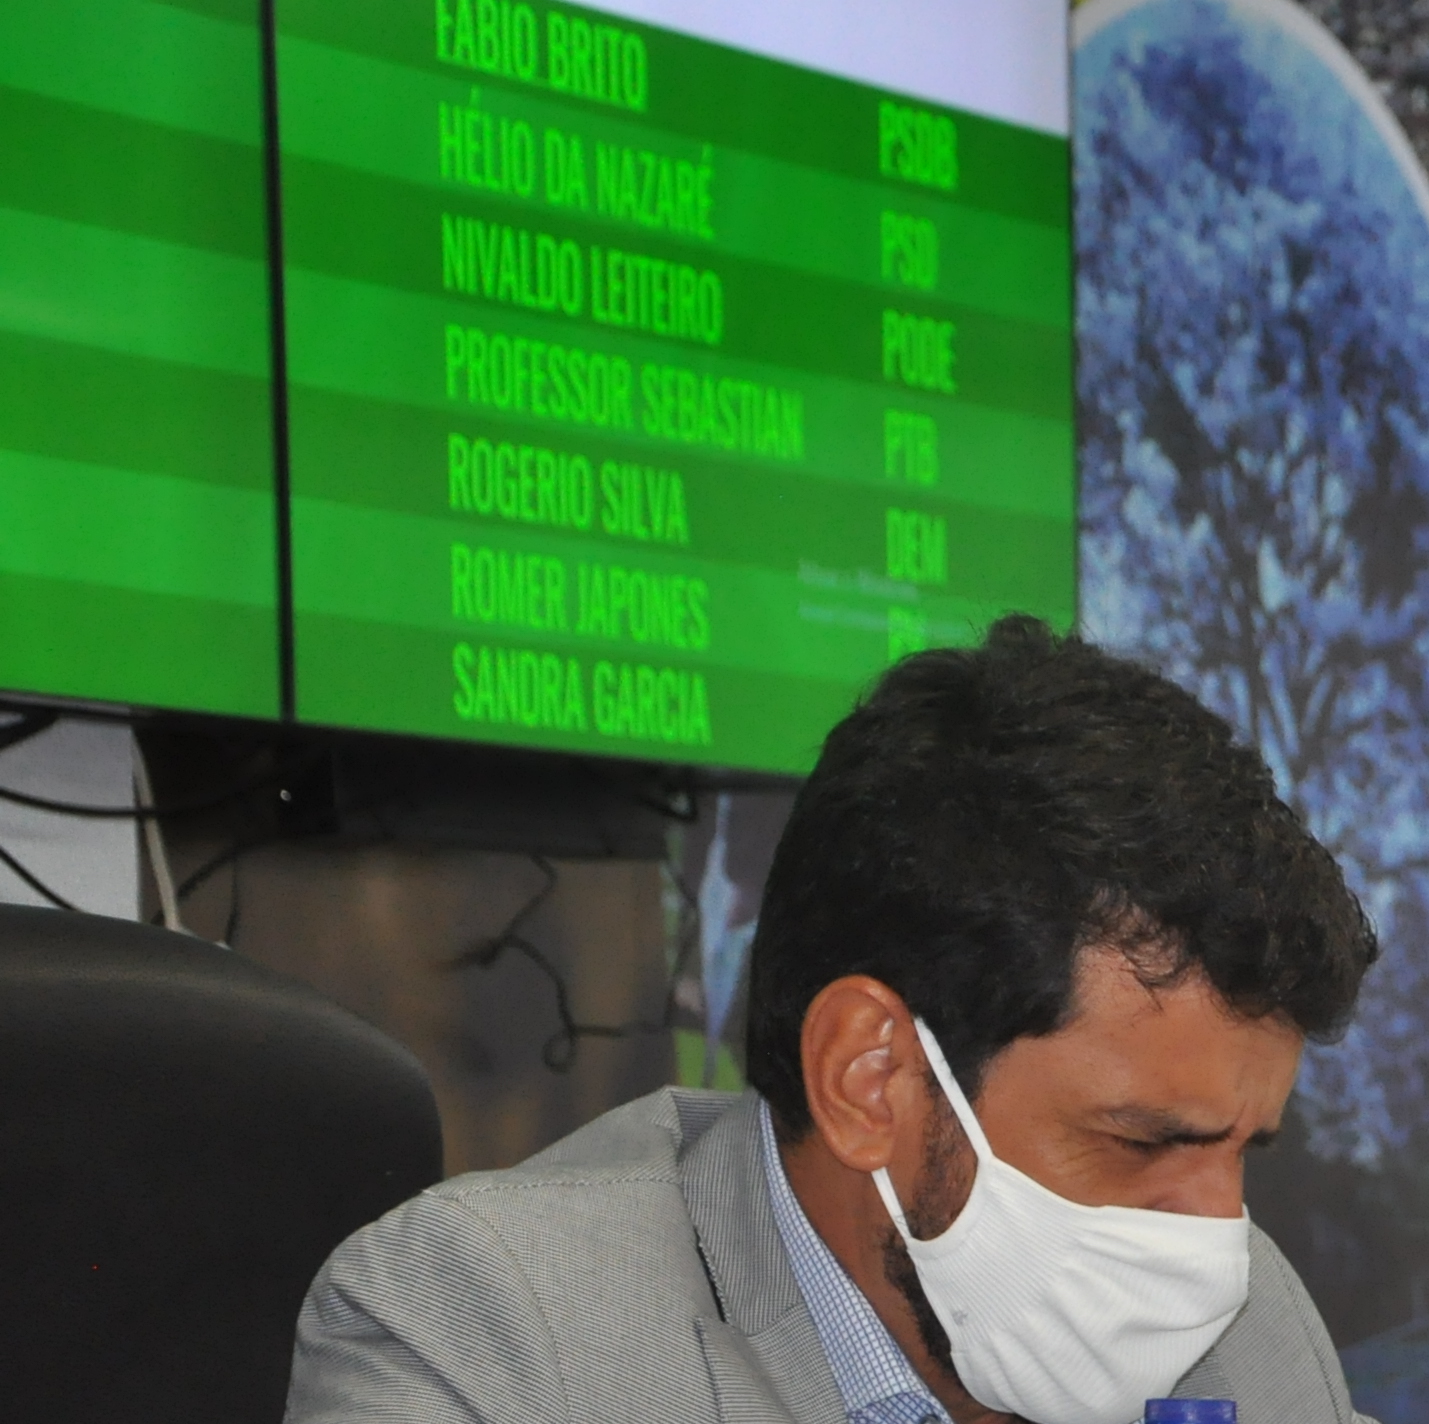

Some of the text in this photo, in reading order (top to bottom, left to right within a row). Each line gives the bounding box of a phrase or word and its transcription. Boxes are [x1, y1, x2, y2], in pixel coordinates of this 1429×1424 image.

[547, 11, 646, 112] BRITO
[879, 100, 957, 189] PSDB
[438, 85, 533, 197] HÉLIO
[545, 127, 589, 211] DA
[596, 143, 715, 240] NAZARÉ
[442, 212, 582, 316] NIVALDO
[591, 245, 723, 345] LEITEIRO
[446, 323, 635, 431] PROFESSOR
[449, 432, 592, 531] ROGERIO
[601, 459, 689, 544] SILVA
[452, 542, 567, 632] ROMER
[453, 641, 712, 746] SANDRA GARCIA
